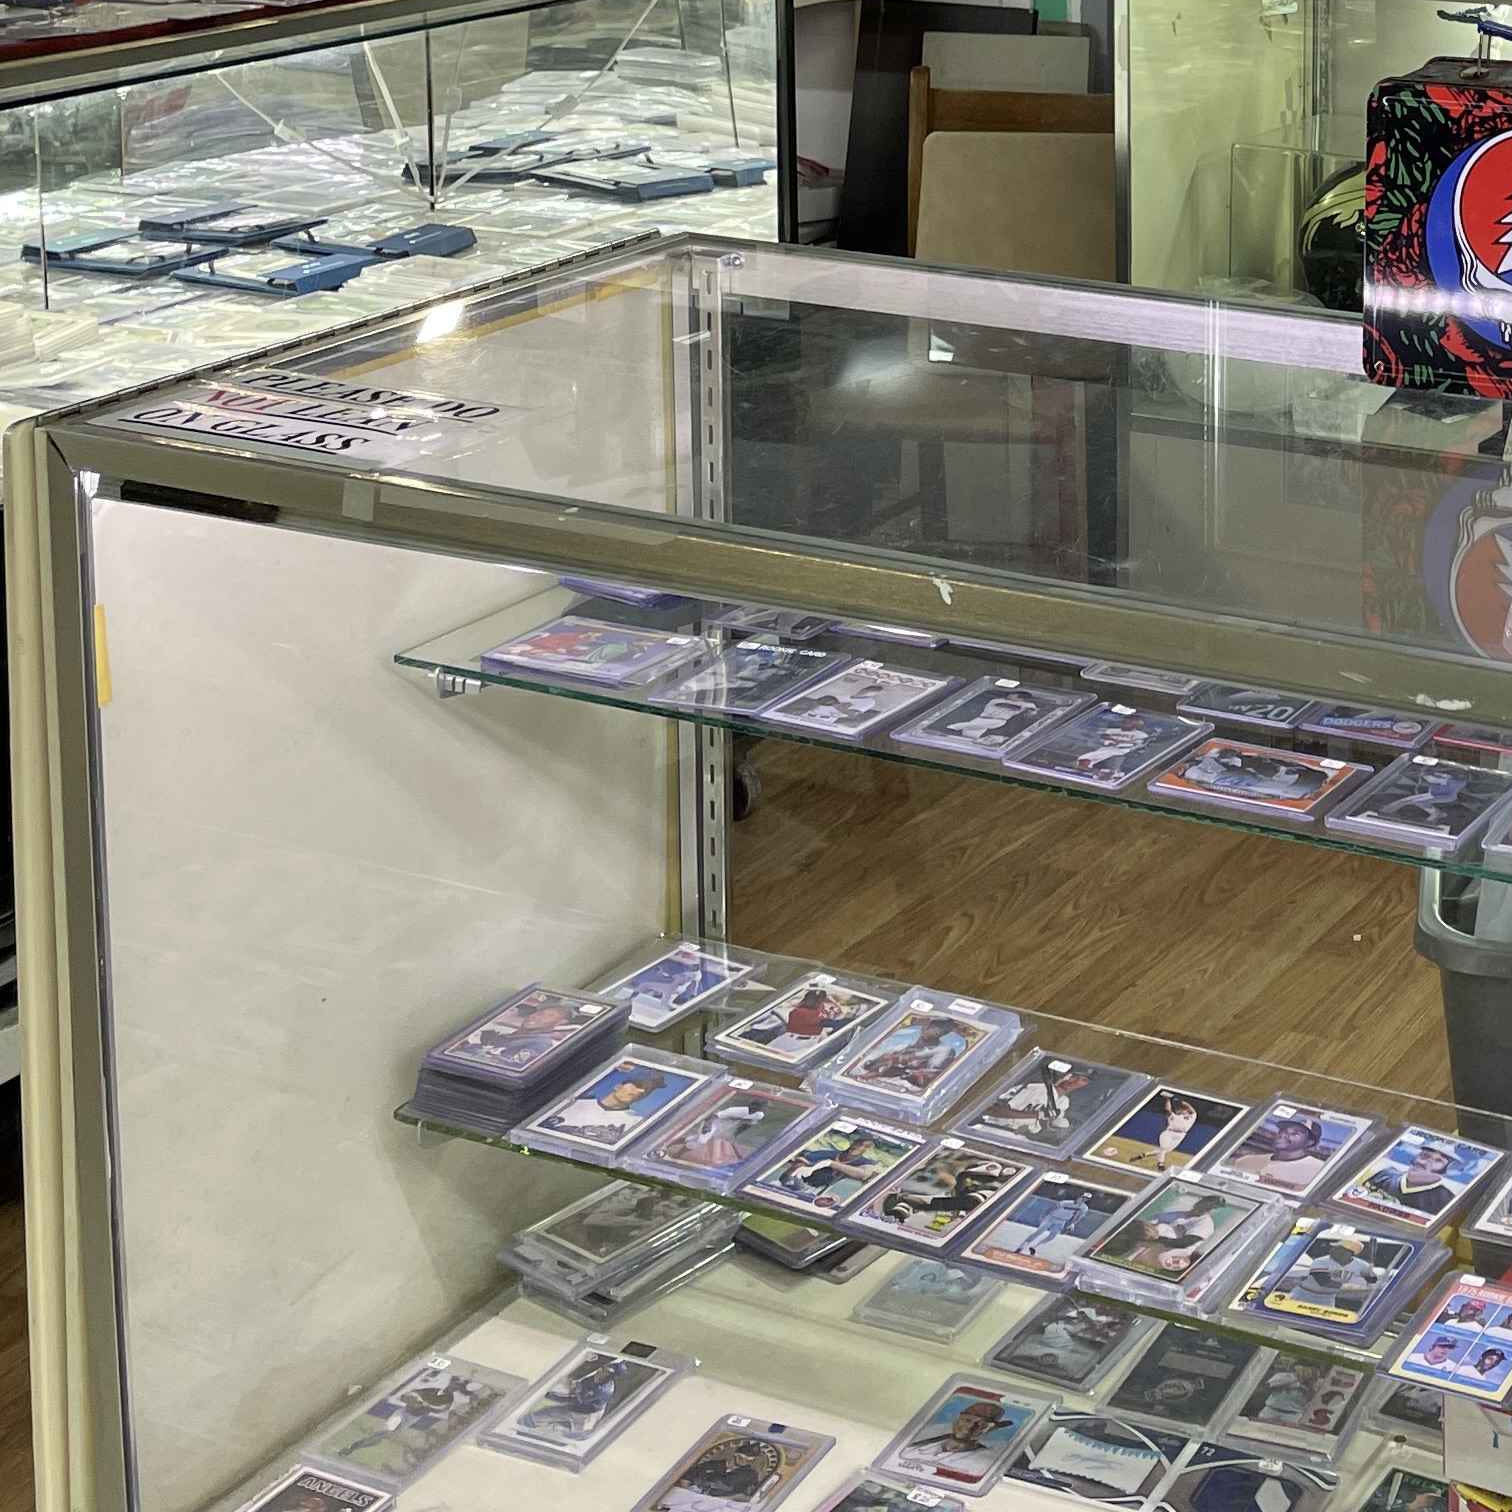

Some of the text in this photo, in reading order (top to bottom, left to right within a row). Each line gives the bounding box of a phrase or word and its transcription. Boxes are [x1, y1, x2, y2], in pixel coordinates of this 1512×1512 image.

[203, 388, 431, 432] NOT LEAN
[244, 373, 501, 419] PLEASE DO
[134, 407, 372, 453] ON GLASS
[1319, 715, 1397, 730] DODGERS
[1415, 1130, 1487, 1157] ROOKIE CARD
[298, 1476, 374, 1508] ANGELS
